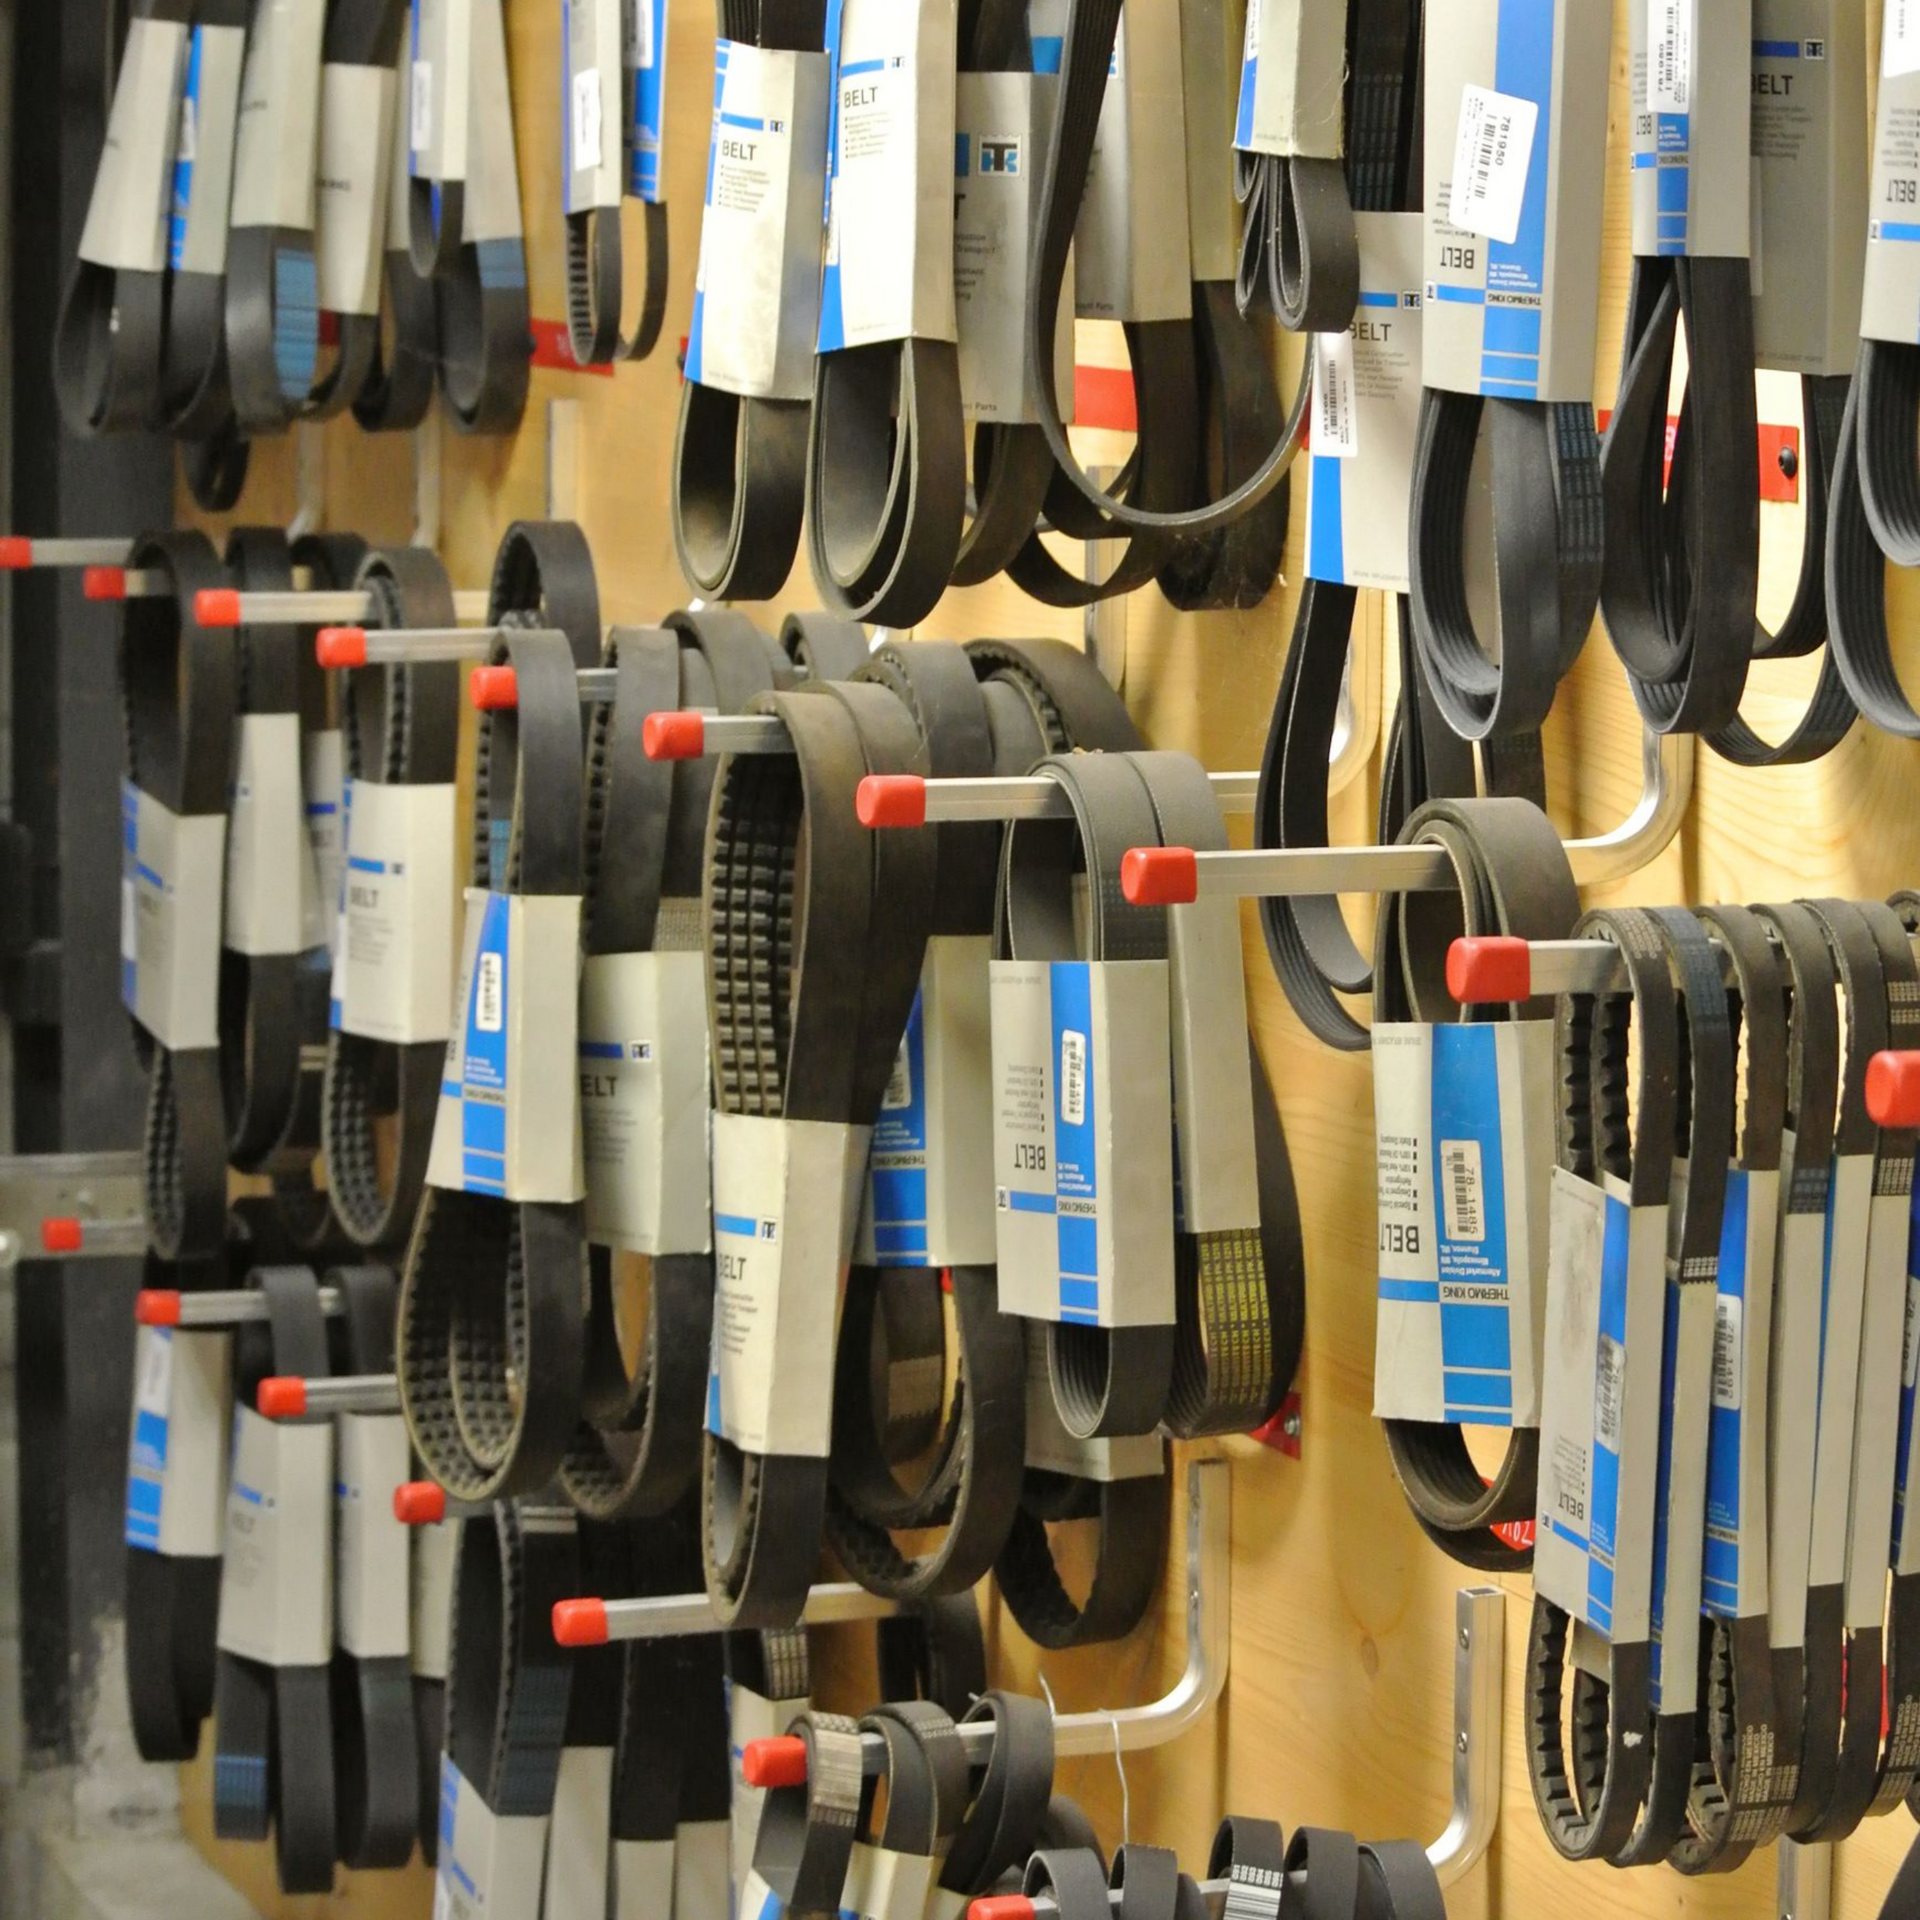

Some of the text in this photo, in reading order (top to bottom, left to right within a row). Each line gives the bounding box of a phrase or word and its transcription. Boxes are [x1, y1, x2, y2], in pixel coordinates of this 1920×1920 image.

[844, 86, 878, 108] BELT
[722, 139, 757, 161] BELT
[1494, 116, 1511, 167] 781950
[1886, 178, 1917, 203] BELT
[1440, 246, 1475, 269] BELT
[1487, 293, 1541, 306] THERMO KING
[1348, 321, 1392, 342] BELT
[580, 1074, 617, 1097] ELT
[1014, 1144, 1046, 1171] BELT
[1465, 1167, 1478, 1235] 78-1485
[1381, 1223, 1420, 1254] BELT
[1441, 1266, 1501, 1277] Aftermarket Division
[1443, 1286, 1510, 1301] THERMO KING
[1558, 1491, 1584, 1521] BELT
[1759, 1725, 1767, 1758] MEXICO
[1766, 1732, 1774, 1766] MEXICO
